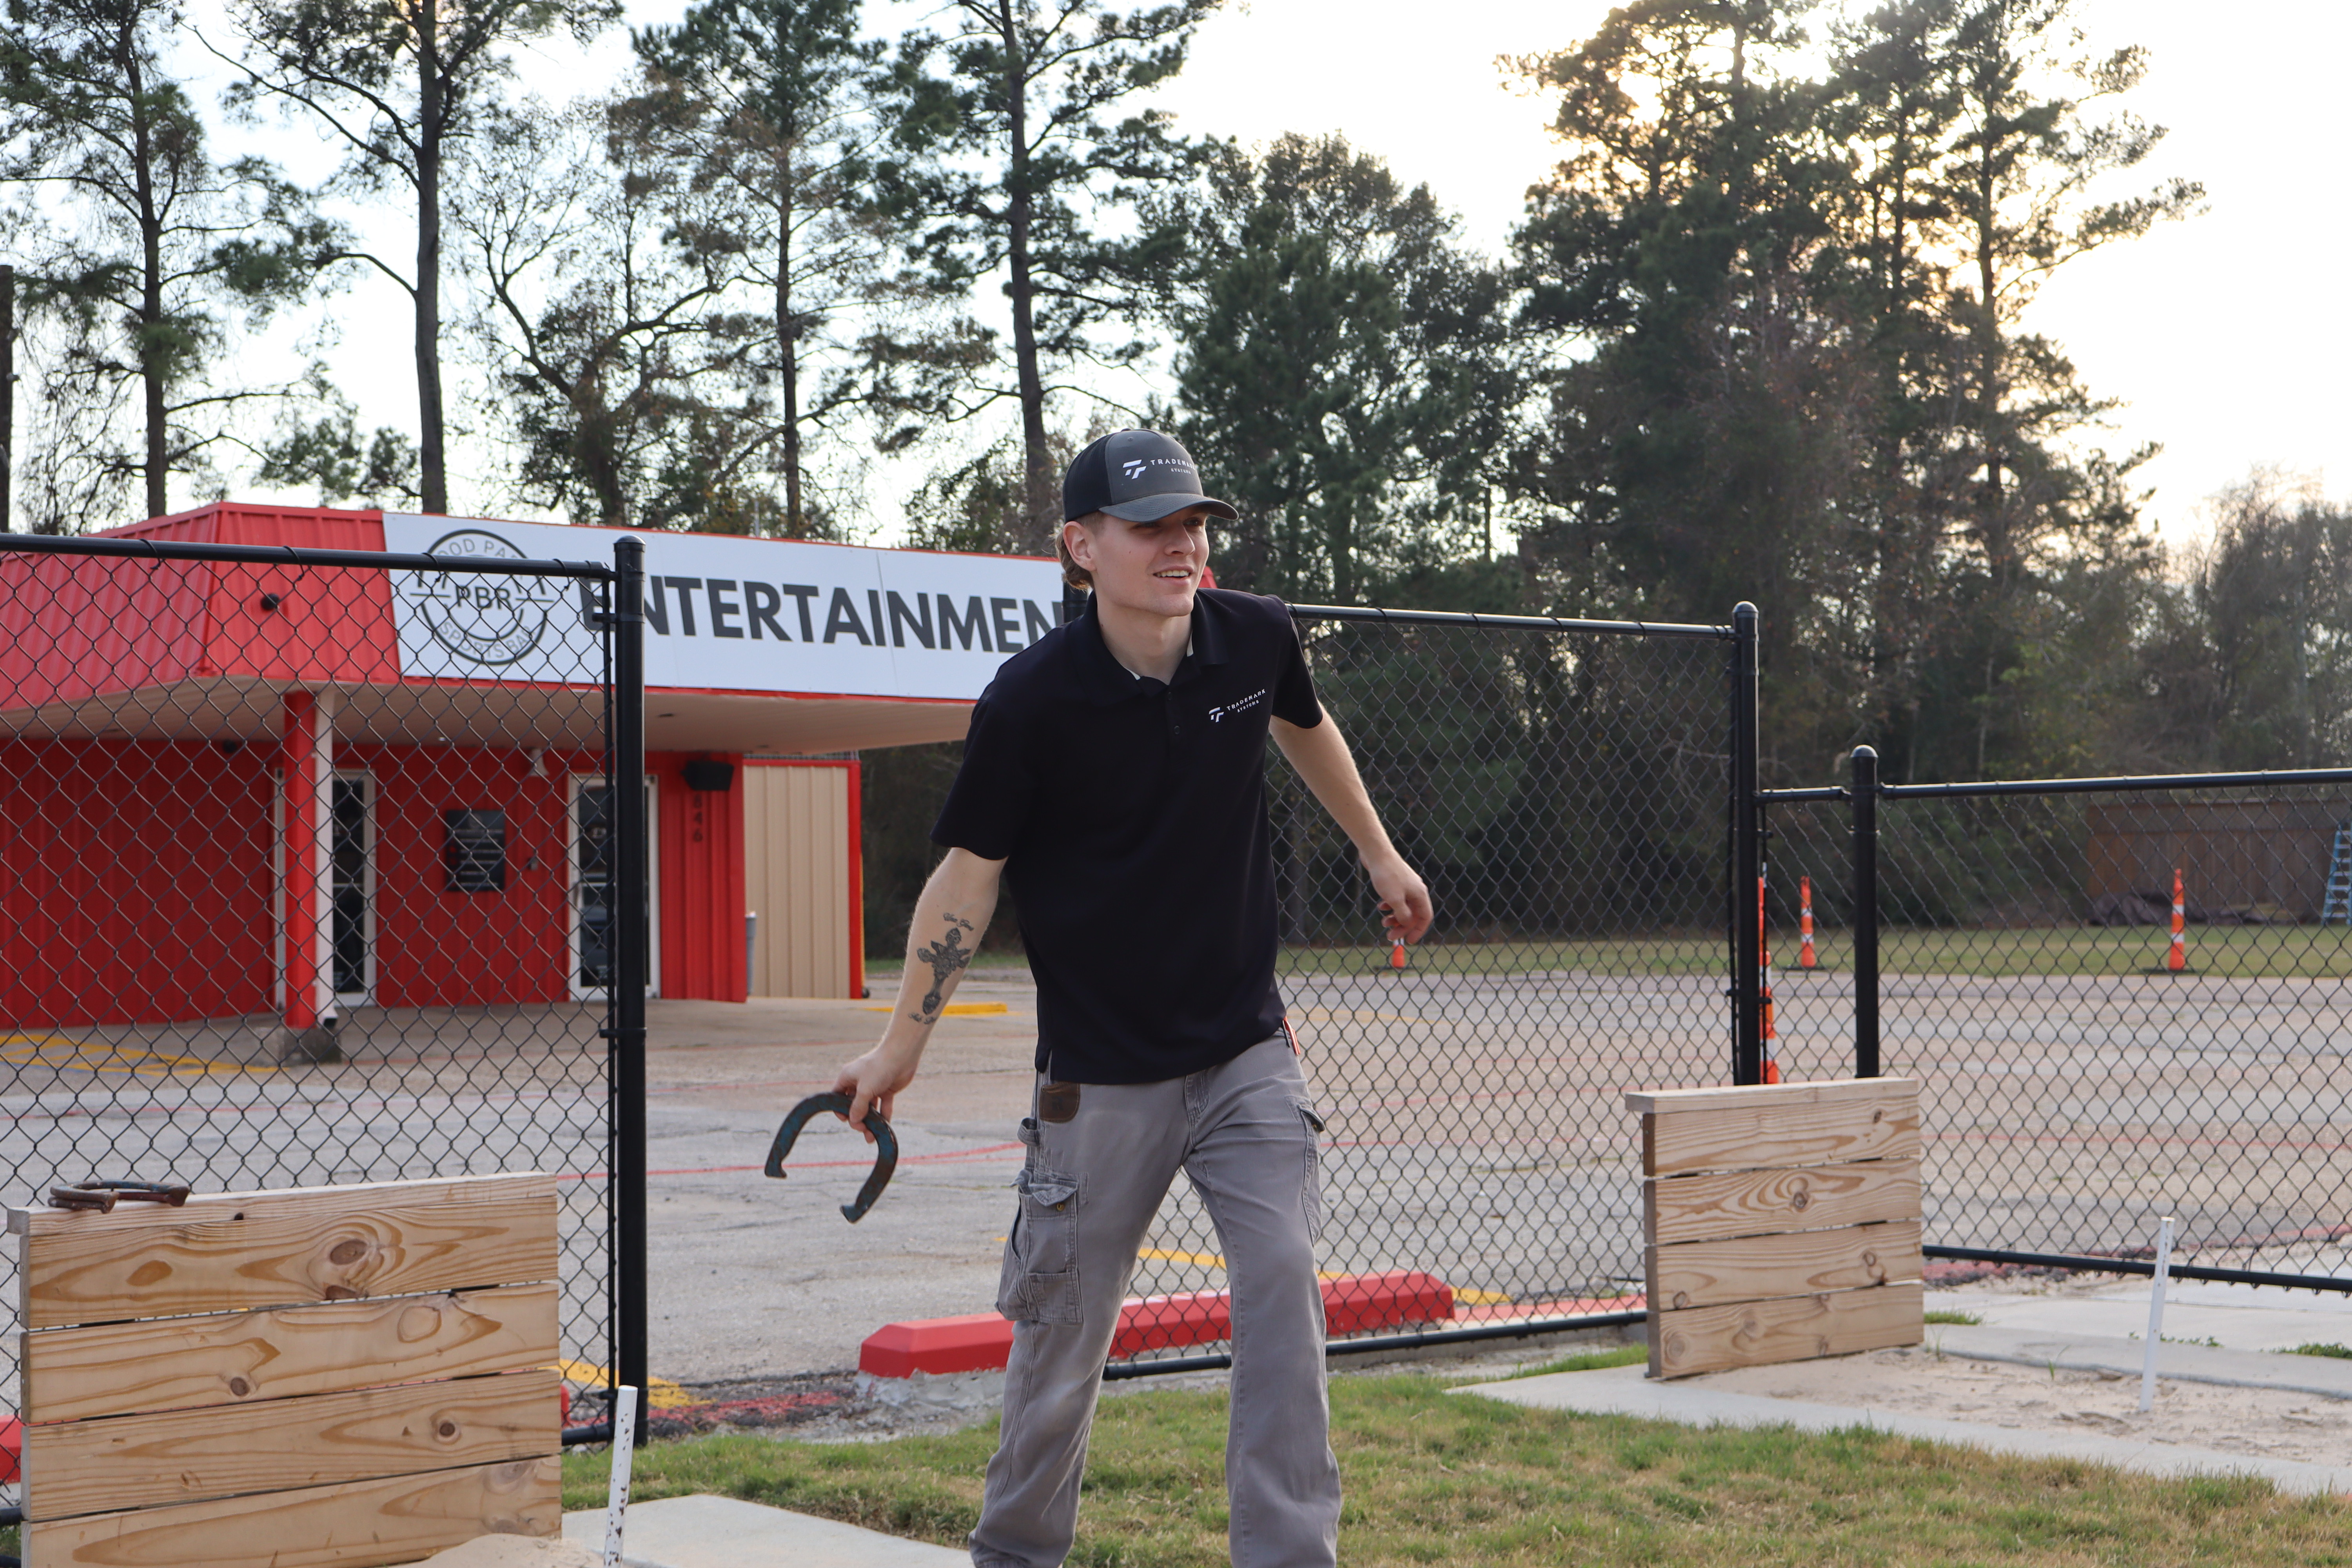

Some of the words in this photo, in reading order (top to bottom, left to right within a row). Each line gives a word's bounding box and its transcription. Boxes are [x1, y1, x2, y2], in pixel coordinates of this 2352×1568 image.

[1150, 458, 1196, 470] TRADEMARK
[455, 585, 513, 610] PBR
[440, 621, 505, 658] SPORTS
[1226, 688, 1266, 711] TRADEMARK
[1236, 699, 1259, 713] SYSTEMS
